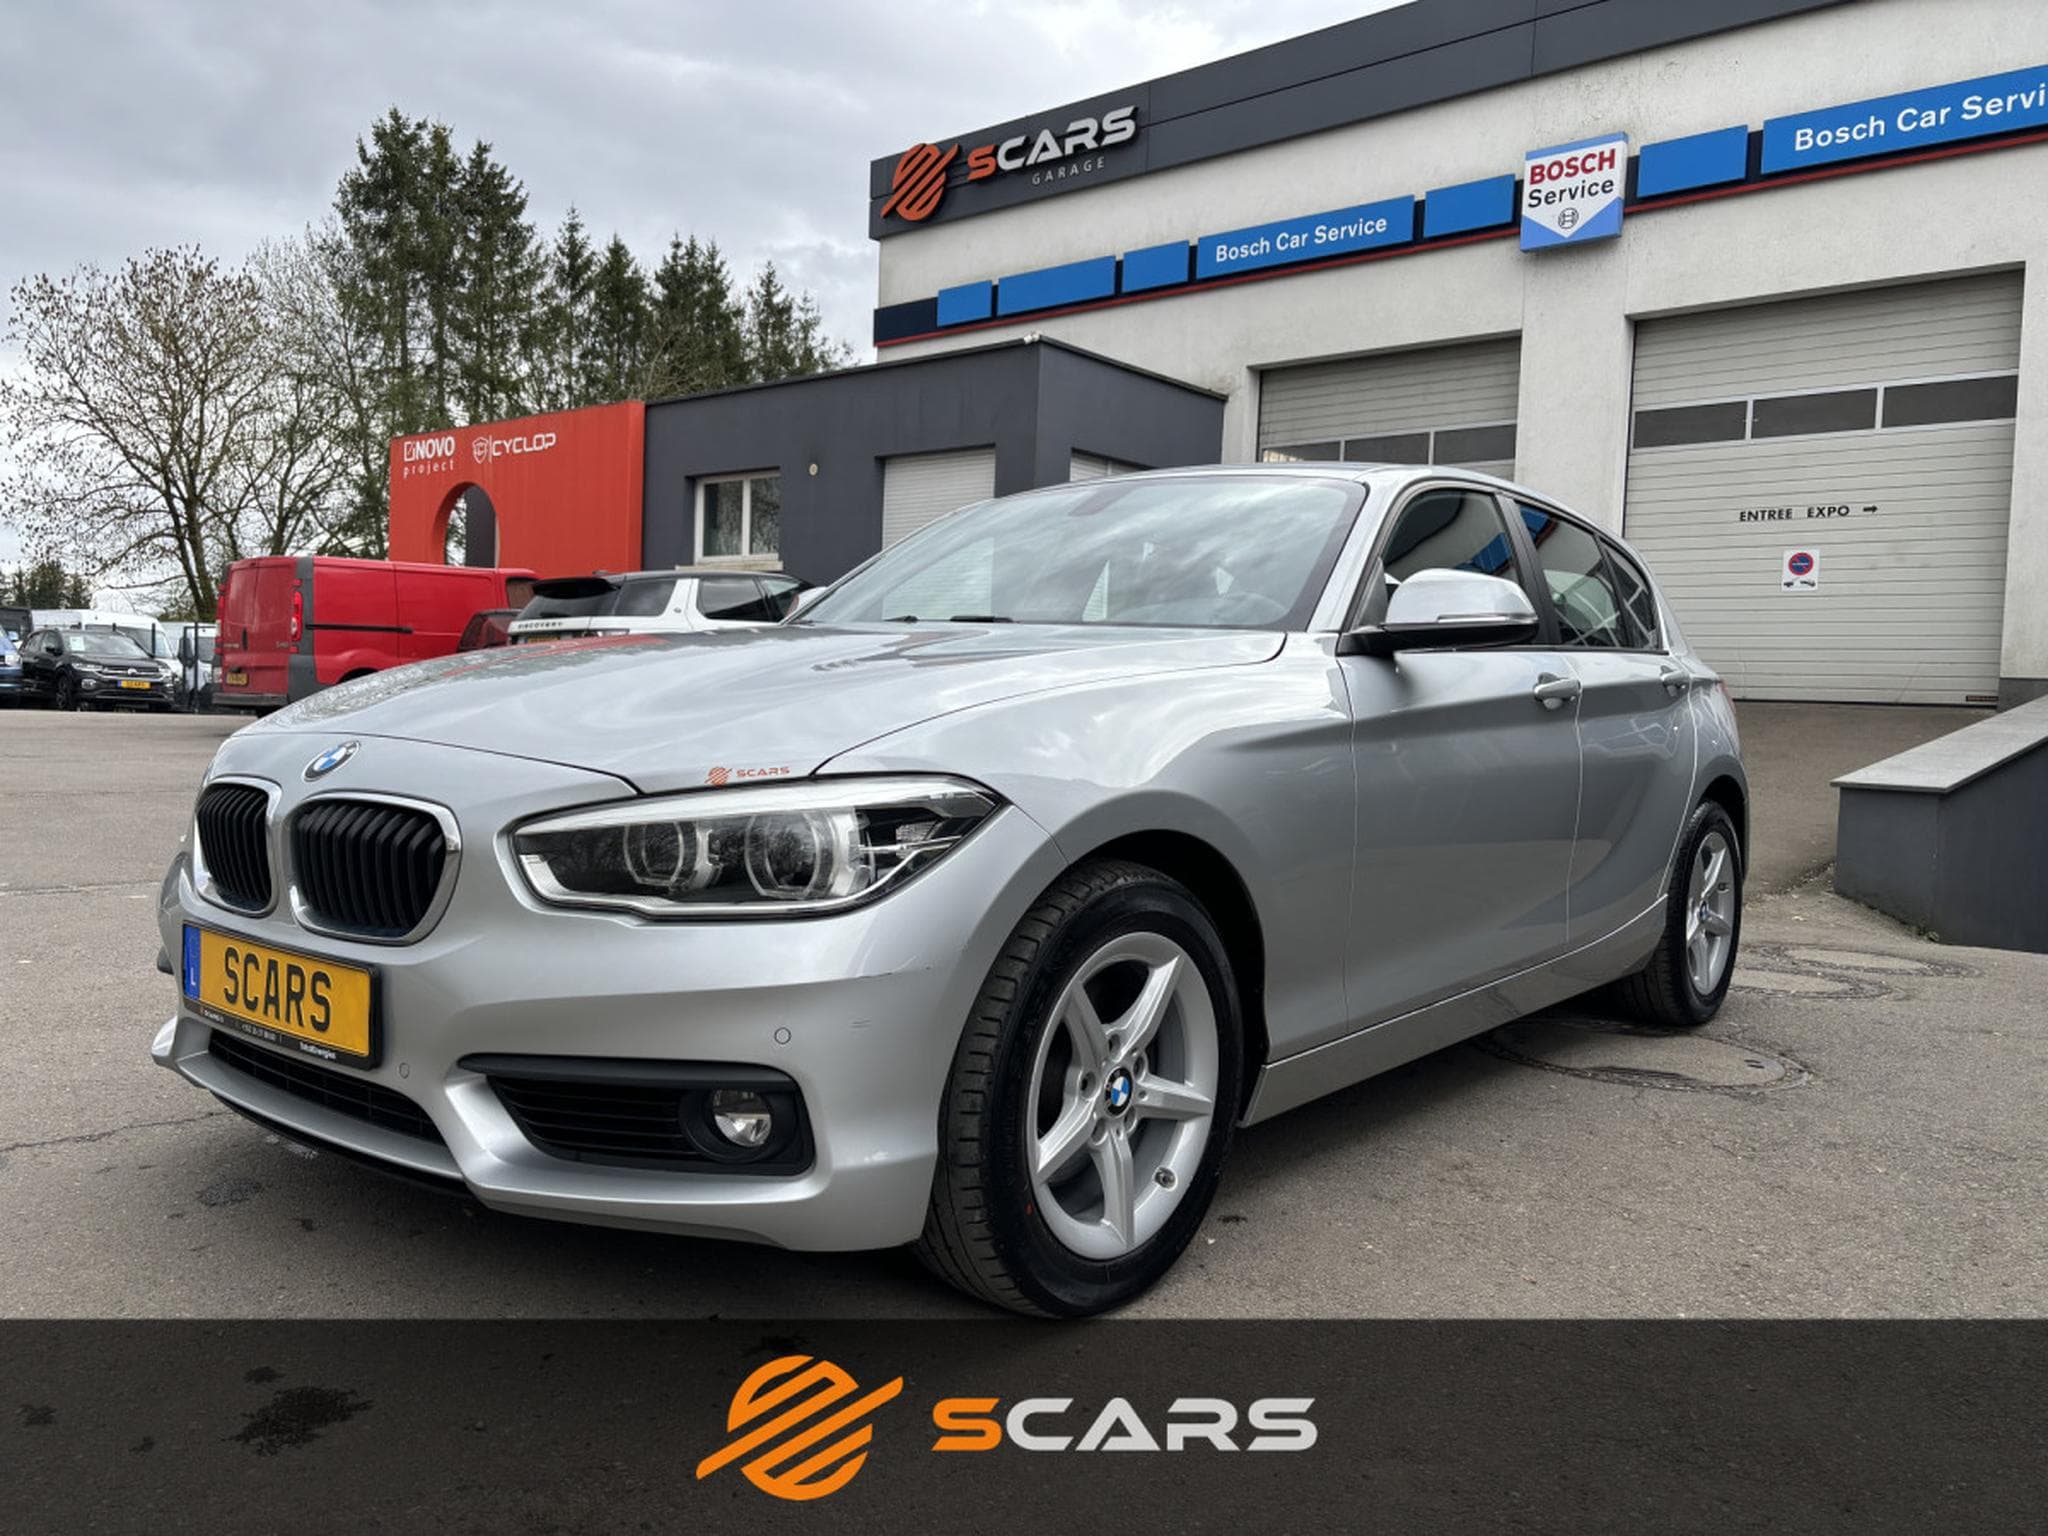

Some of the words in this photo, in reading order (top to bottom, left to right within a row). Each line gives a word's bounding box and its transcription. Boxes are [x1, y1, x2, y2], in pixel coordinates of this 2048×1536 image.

[967, 105, 1137, 181] SCARS
[1795, 115, 1885, 151] Bosch
[1896, 106, 1952, 132] Car
[1031, 156, 1106, 185] GARAGE
[1529, 148, 1616, 185] BOSCH
[1527, 179, 1614, 208] Service
[1215, 236, 1271, 262] Bosch
[1276, 231, 1309, 251] Car
[1313, 217, 1388, 244] Service
[492, 432, 557, 457] CYCLOP
[403, 459, 455, 479] project
[1739, 508, 1793, 522] ENTREE
[1806, 505, 1850, 519] EXPO
[736, 767, 790, 777] SCARS
[224, 947, 331, 1032] SCARS
